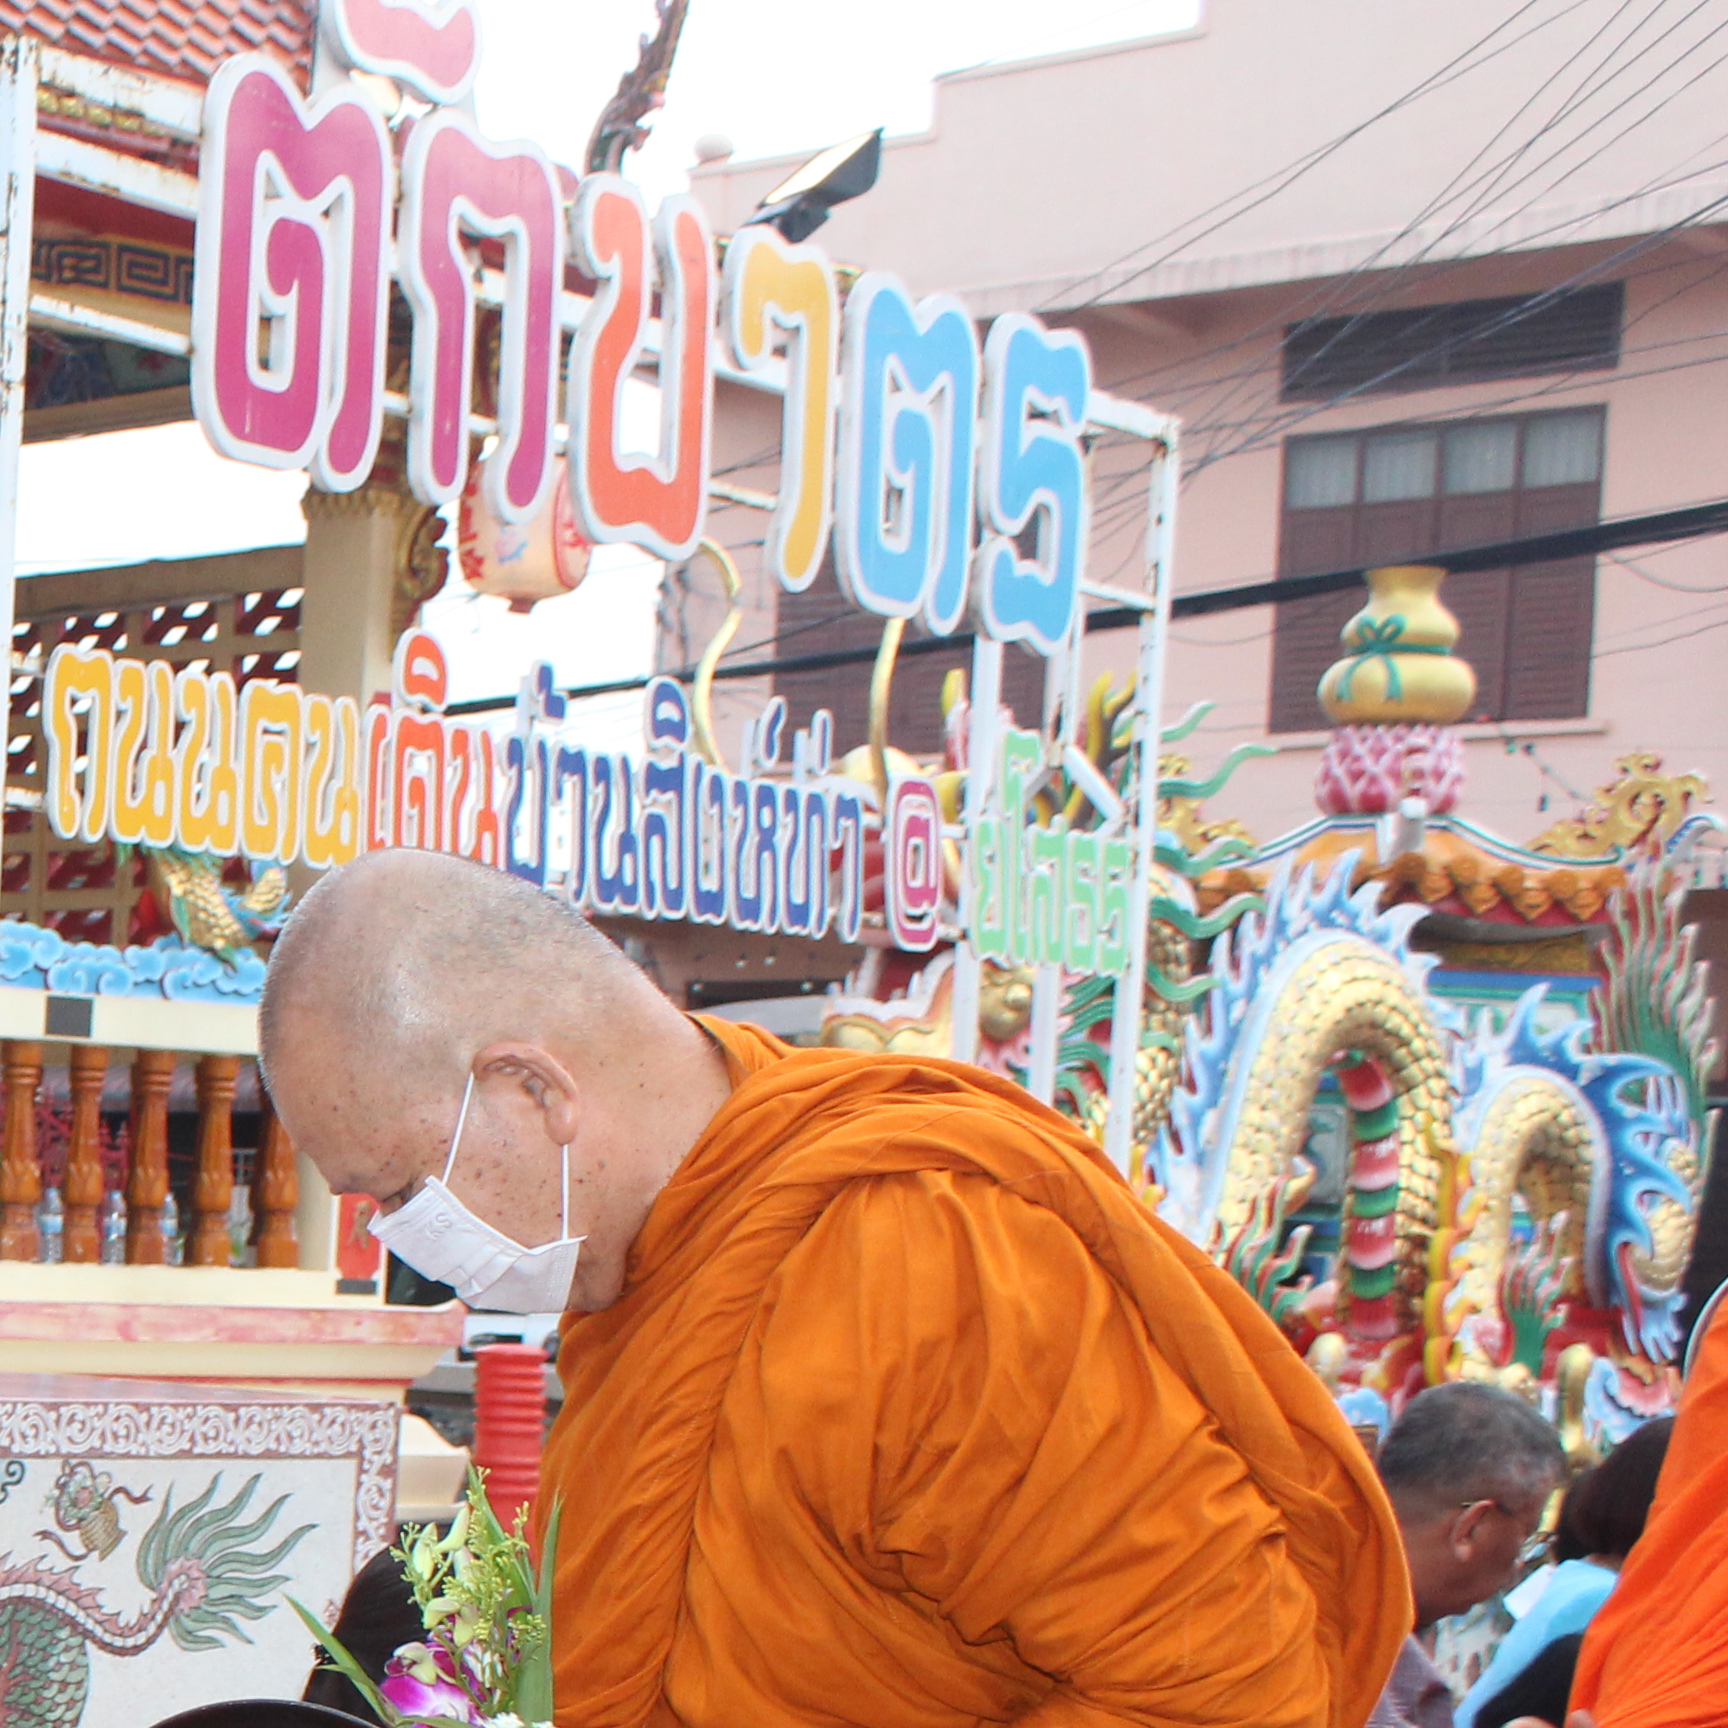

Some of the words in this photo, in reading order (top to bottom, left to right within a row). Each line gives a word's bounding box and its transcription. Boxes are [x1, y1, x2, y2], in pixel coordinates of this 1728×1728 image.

[192, 0, 1093, 656] ตักบาตร
[887, 776, 942, 952] @
